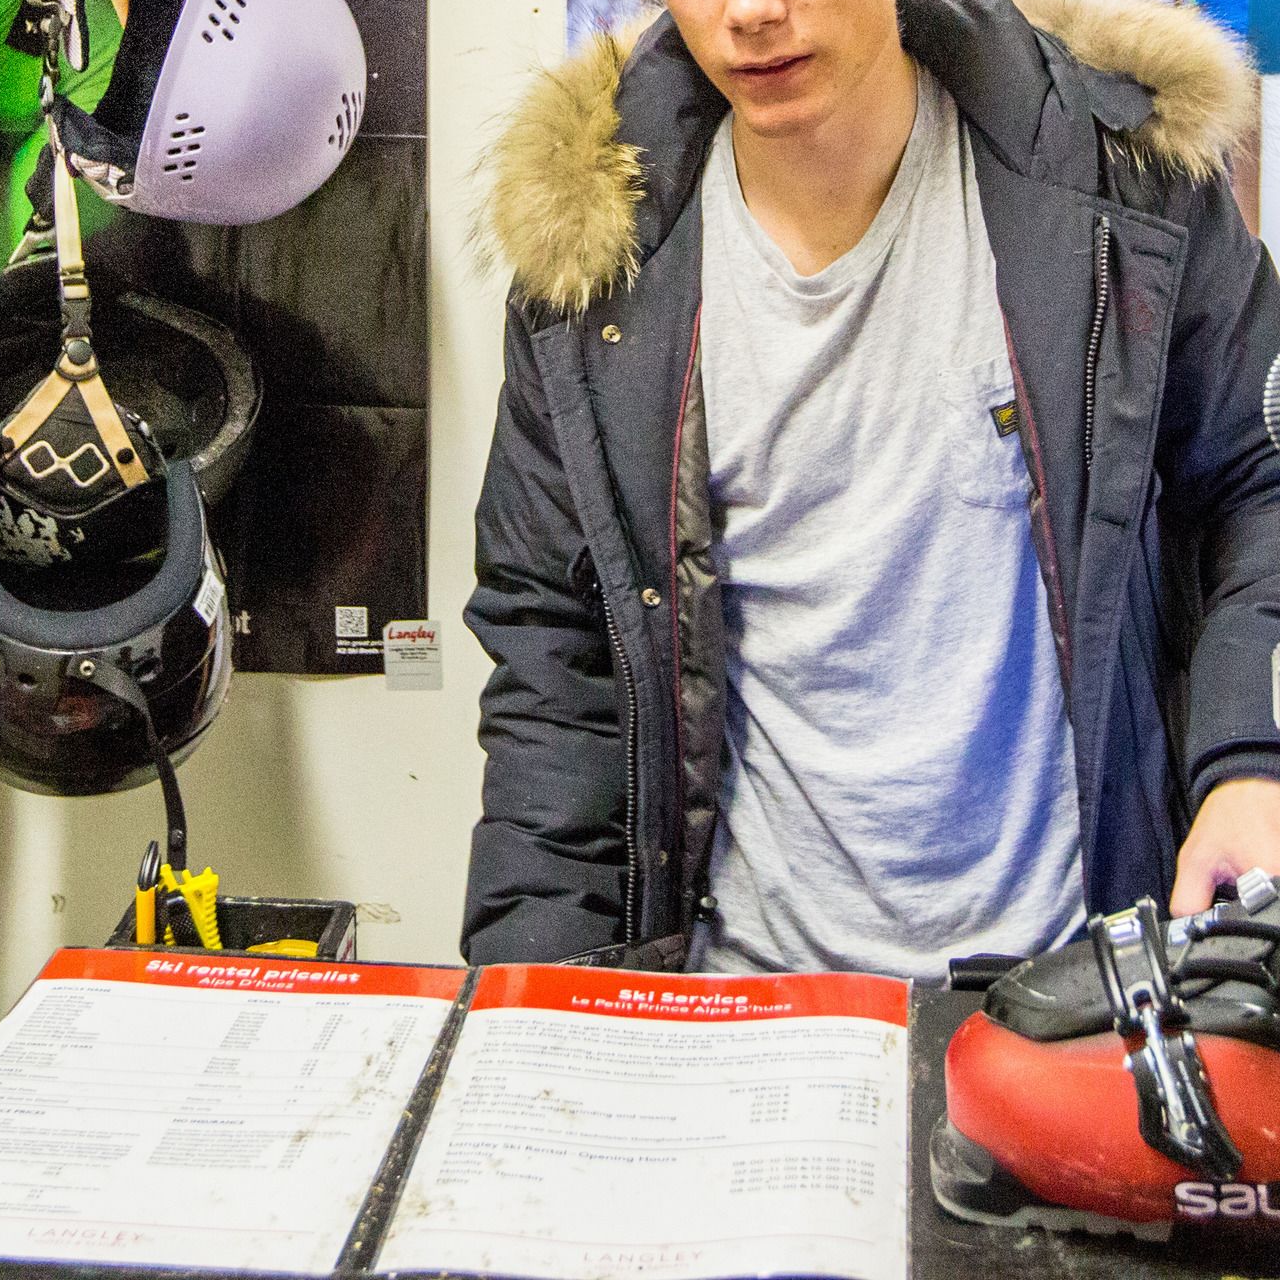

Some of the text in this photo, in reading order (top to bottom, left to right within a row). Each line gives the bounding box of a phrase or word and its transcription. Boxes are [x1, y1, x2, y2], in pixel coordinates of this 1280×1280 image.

[388, 625, 435, 644] Langley
[146, 959, 360, 984] Ski rental pricelist
[198, 975, 234, 989] Alpe
[571, 994, 589, 1007] Le
[595, 997, 633, 1012] Petit
[638, 1002, 694, 1014] Prince
[697, 1003, 730, 1017] Alpe
[618, 989, 749, 1005] Ski Service
[448, 1141, 498, 1149] Langley
[525, 1145, 568, 1156] Rental
[577, 1152, 634, 1163] Opening
[28, 1227, 145, 1241] LANGLEY
[583, 1251, 704, 1264] LANGLEY
